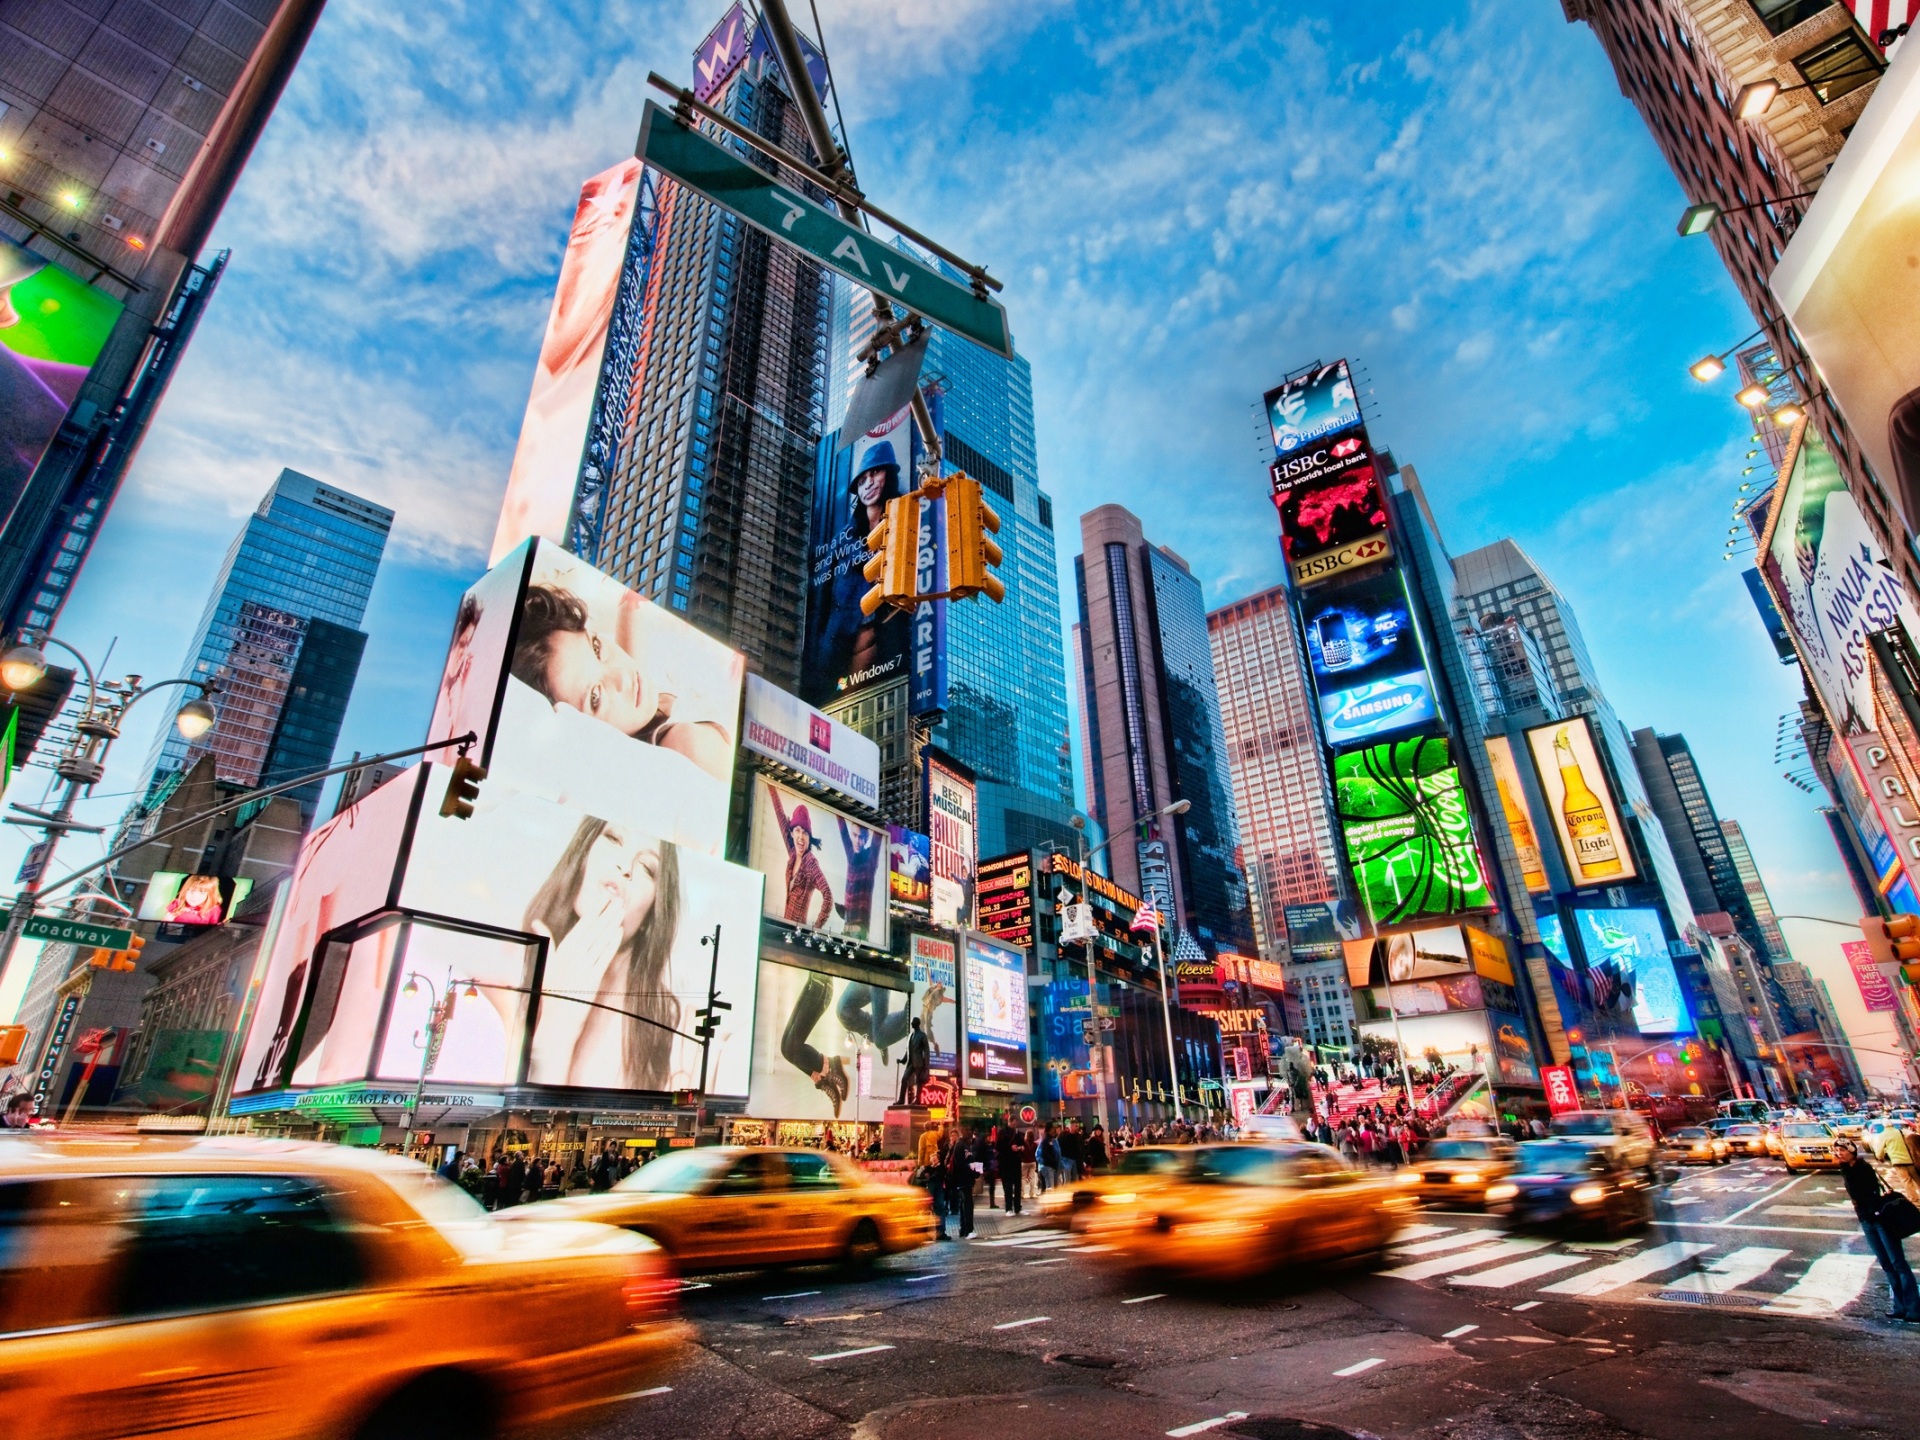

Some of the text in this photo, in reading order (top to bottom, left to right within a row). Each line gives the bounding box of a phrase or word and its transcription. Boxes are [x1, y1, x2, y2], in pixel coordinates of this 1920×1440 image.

[697, 18, 738, 84] W
[770, 190, 806, 232] 7
[831, 235, 911, 293] Av
[599, 256, 644, 463] AMERICAN EAGLE
[613, 304, 646, 444] OUTFITTERS
[1298, 410, 1360, 442] Prudential
[1273, 449, 1329, 482] HSBC
[1276, 452, 1368, 492] The world's local bank
[813, 535, 869, 573] and Windo
[814, 526, 854, 558] I'm a PC
[813, 571, 832, 587] was
[834, 561, 850, 576] my
[1296, 549, 1354, 579] HSBC
[914, 524, 936, 674] SQUARE
[1825, 554, 1872, 640] NINJA
[849, 653, 903, 686] Windows 7
[916, 688, 933, 700] NYC
[1343, 692, 1413, 721] SAMSUNG
[748, 720, 876, 801] READY FOR HOLIDAY CHEER
[933, 792, 972, 826] MUSICAL
[941, 784, 963, 807] BEST
[933, 810, 960, 852] BILLY
[1346, 815, 1416, 838] display powered
[1567, 811, 1604, 827] Corona
[1350, 826, 1415, 845] by wind energy
[1578, 837, 1611, 853] Light
[934, 842, 965, 885] ELLIOT
[978, 855, 1028, 874] THOMSON REUTERS
[1138, 841, 1171, 917] SHEY'S
[30, 921, 112, 946] roadway
[917, 937, 954, 963] HEIGHTS
[913, 965, 928, 983] BEST
[1176, 962, 1215, 976] Reese's
[1856, 963, 1879, 972] FREE
[1860, 971, 1880, 980] WIFI
[1197, 1008, 1265, 1032] RSHEY'S
[31, 1001, 77, 1115] SCIENTOLOG
[970, 1052, 985, 1069] CNN
[298, 1093, 474, 1106] AMERICAN EAGLE OUTERS
[1120, 1076, 1165, 1101] 1585
[1549, 1069, 1570, 1105] tkts
[1023, 1109, 1034, 1120] W
